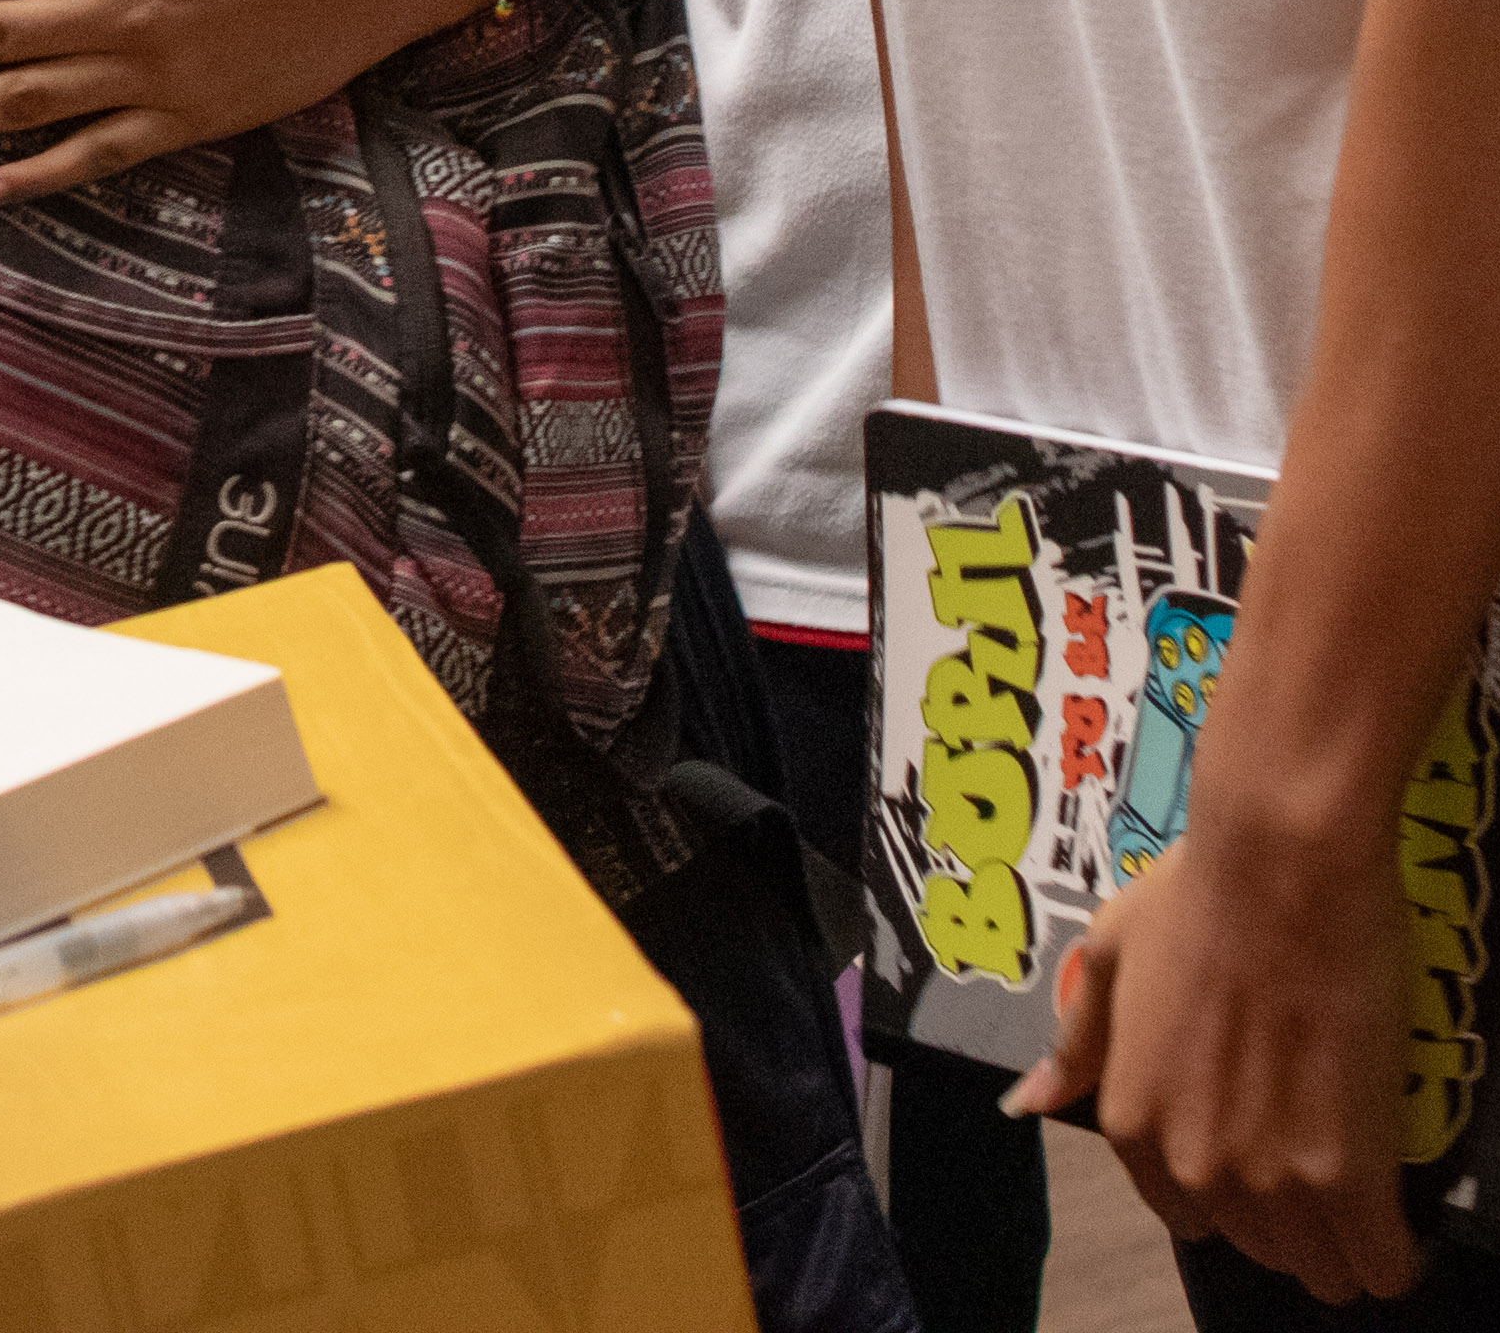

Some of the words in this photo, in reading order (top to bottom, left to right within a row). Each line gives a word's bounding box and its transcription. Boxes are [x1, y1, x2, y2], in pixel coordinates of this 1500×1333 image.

[1062, 591, 1109, 680] BE
[920, 497, 1042, 983] BORN
[1061, 693, 1108, 790] TO
